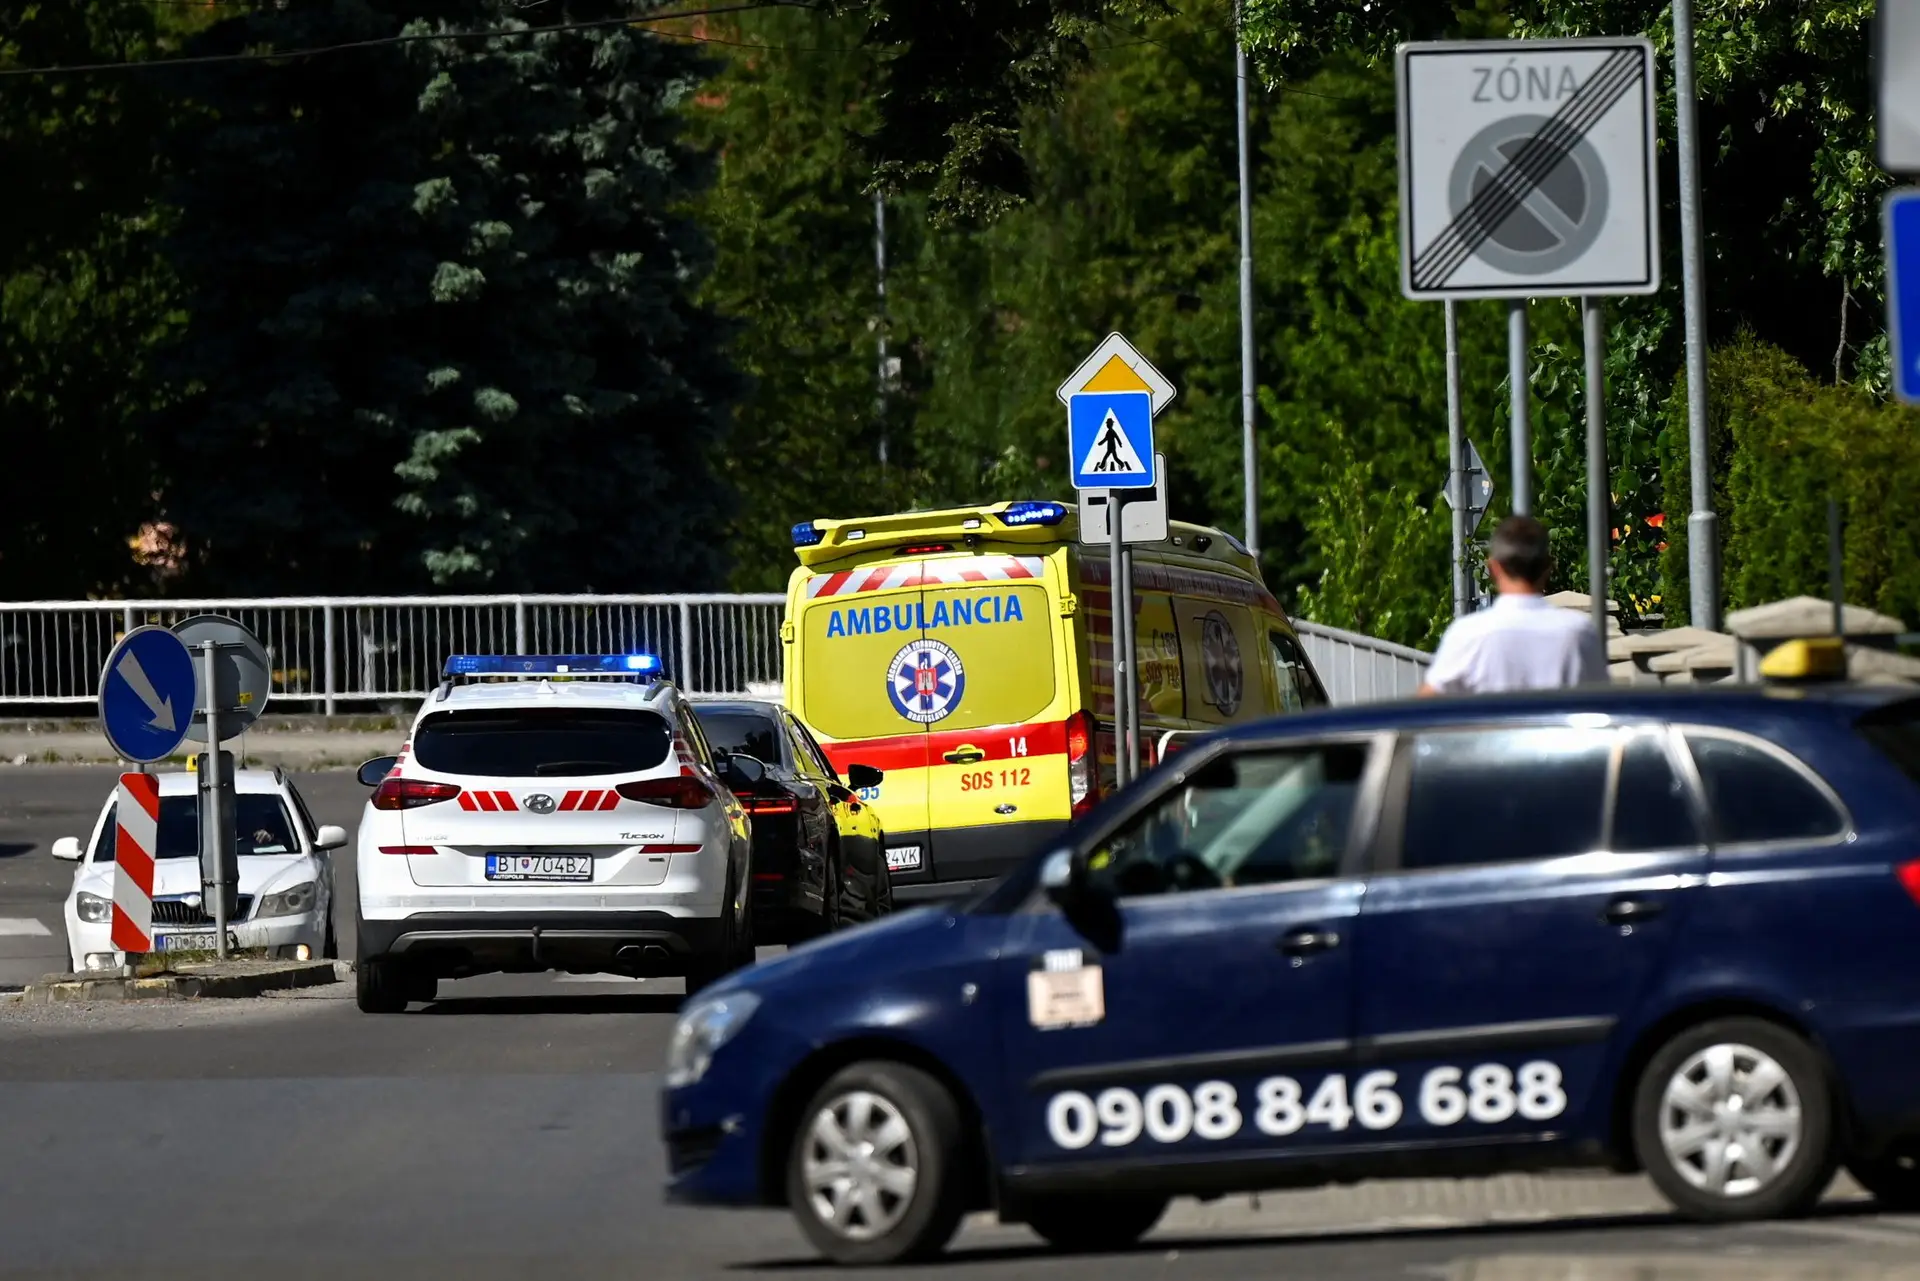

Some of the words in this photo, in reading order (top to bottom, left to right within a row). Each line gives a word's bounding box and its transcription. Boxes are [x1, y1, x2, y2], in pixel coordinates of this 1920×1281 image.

[1472, 57, 1580, 104] ZÓNA
[827, 595, 1023, 638] AMBULANCIA
[1009, 736, 1028, 757] 14
[961, 770, 993, 792] SOS
[999, 768, 1031, 787] 112
[860, 786, 880, 801] 55
[619, 832, 665, 840] TUCSON
[1046, 1080, 1243, 1150] 0908
[1254, 1070, 1403, 1136] 846
[1418, 1060, 1568, 1126] 688
